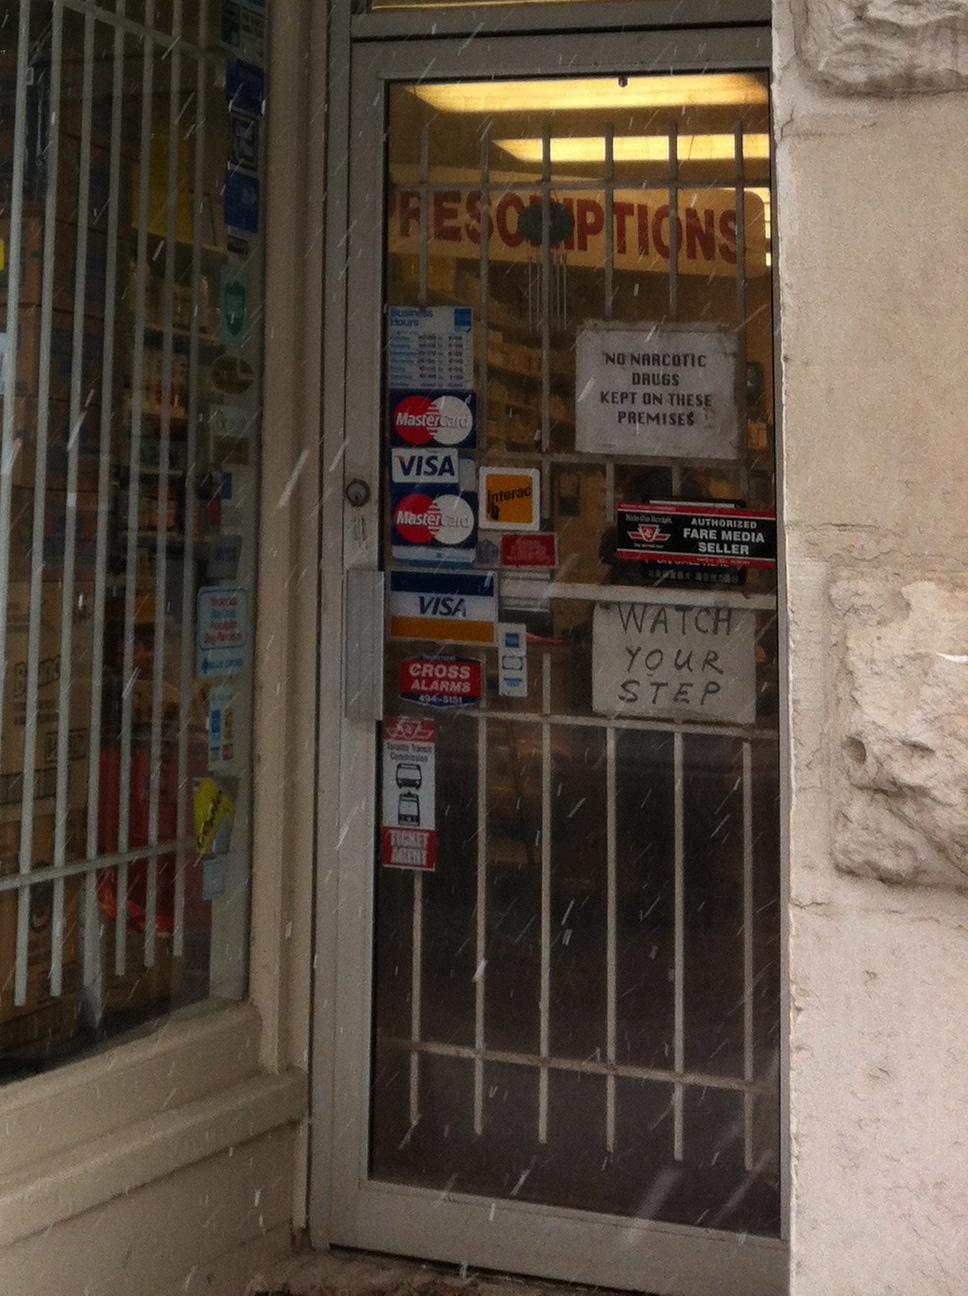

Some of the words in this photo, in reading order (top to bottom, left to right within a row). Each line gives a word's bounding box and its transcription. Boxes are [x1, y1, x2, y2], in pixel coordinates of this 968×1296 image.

[390, 308, 433, 318] Business
[390, 319, 419, 327] Hours
[605, 353, 625, 365] NO
[630, 353, 707, 367] NARCOTIC
[632, 373, 680, 386] DRUGS
[600, 391, 637, 405] KEPT
[642, 392, 663, 405] ON
[668, 393, 712, 406] THESE
[617, 410, 695, 426] PREMISES
[396, 455, 455, 477] VISA
[487, 486, 532, 504] Interac
[691, 518, 758, 530] AUTHORIZED
[683, 528, 718, 541] FARE
[721, 530, 765, 543] MEDIA
[698, 542, 750, 556] SELLER
[417, 595, 467, 618] VISA
[618, 605, 733, 636] WATCH
[624, 646, 725, 676] YOUR
[409, 663, 471, 679] CROSS
[410, 679, 471, 693] ALARMS
[618, 680, 723, 707] STEP
[418, 694, 463, 704] 494-5151
[389, 831, 430, 849] TICKET
